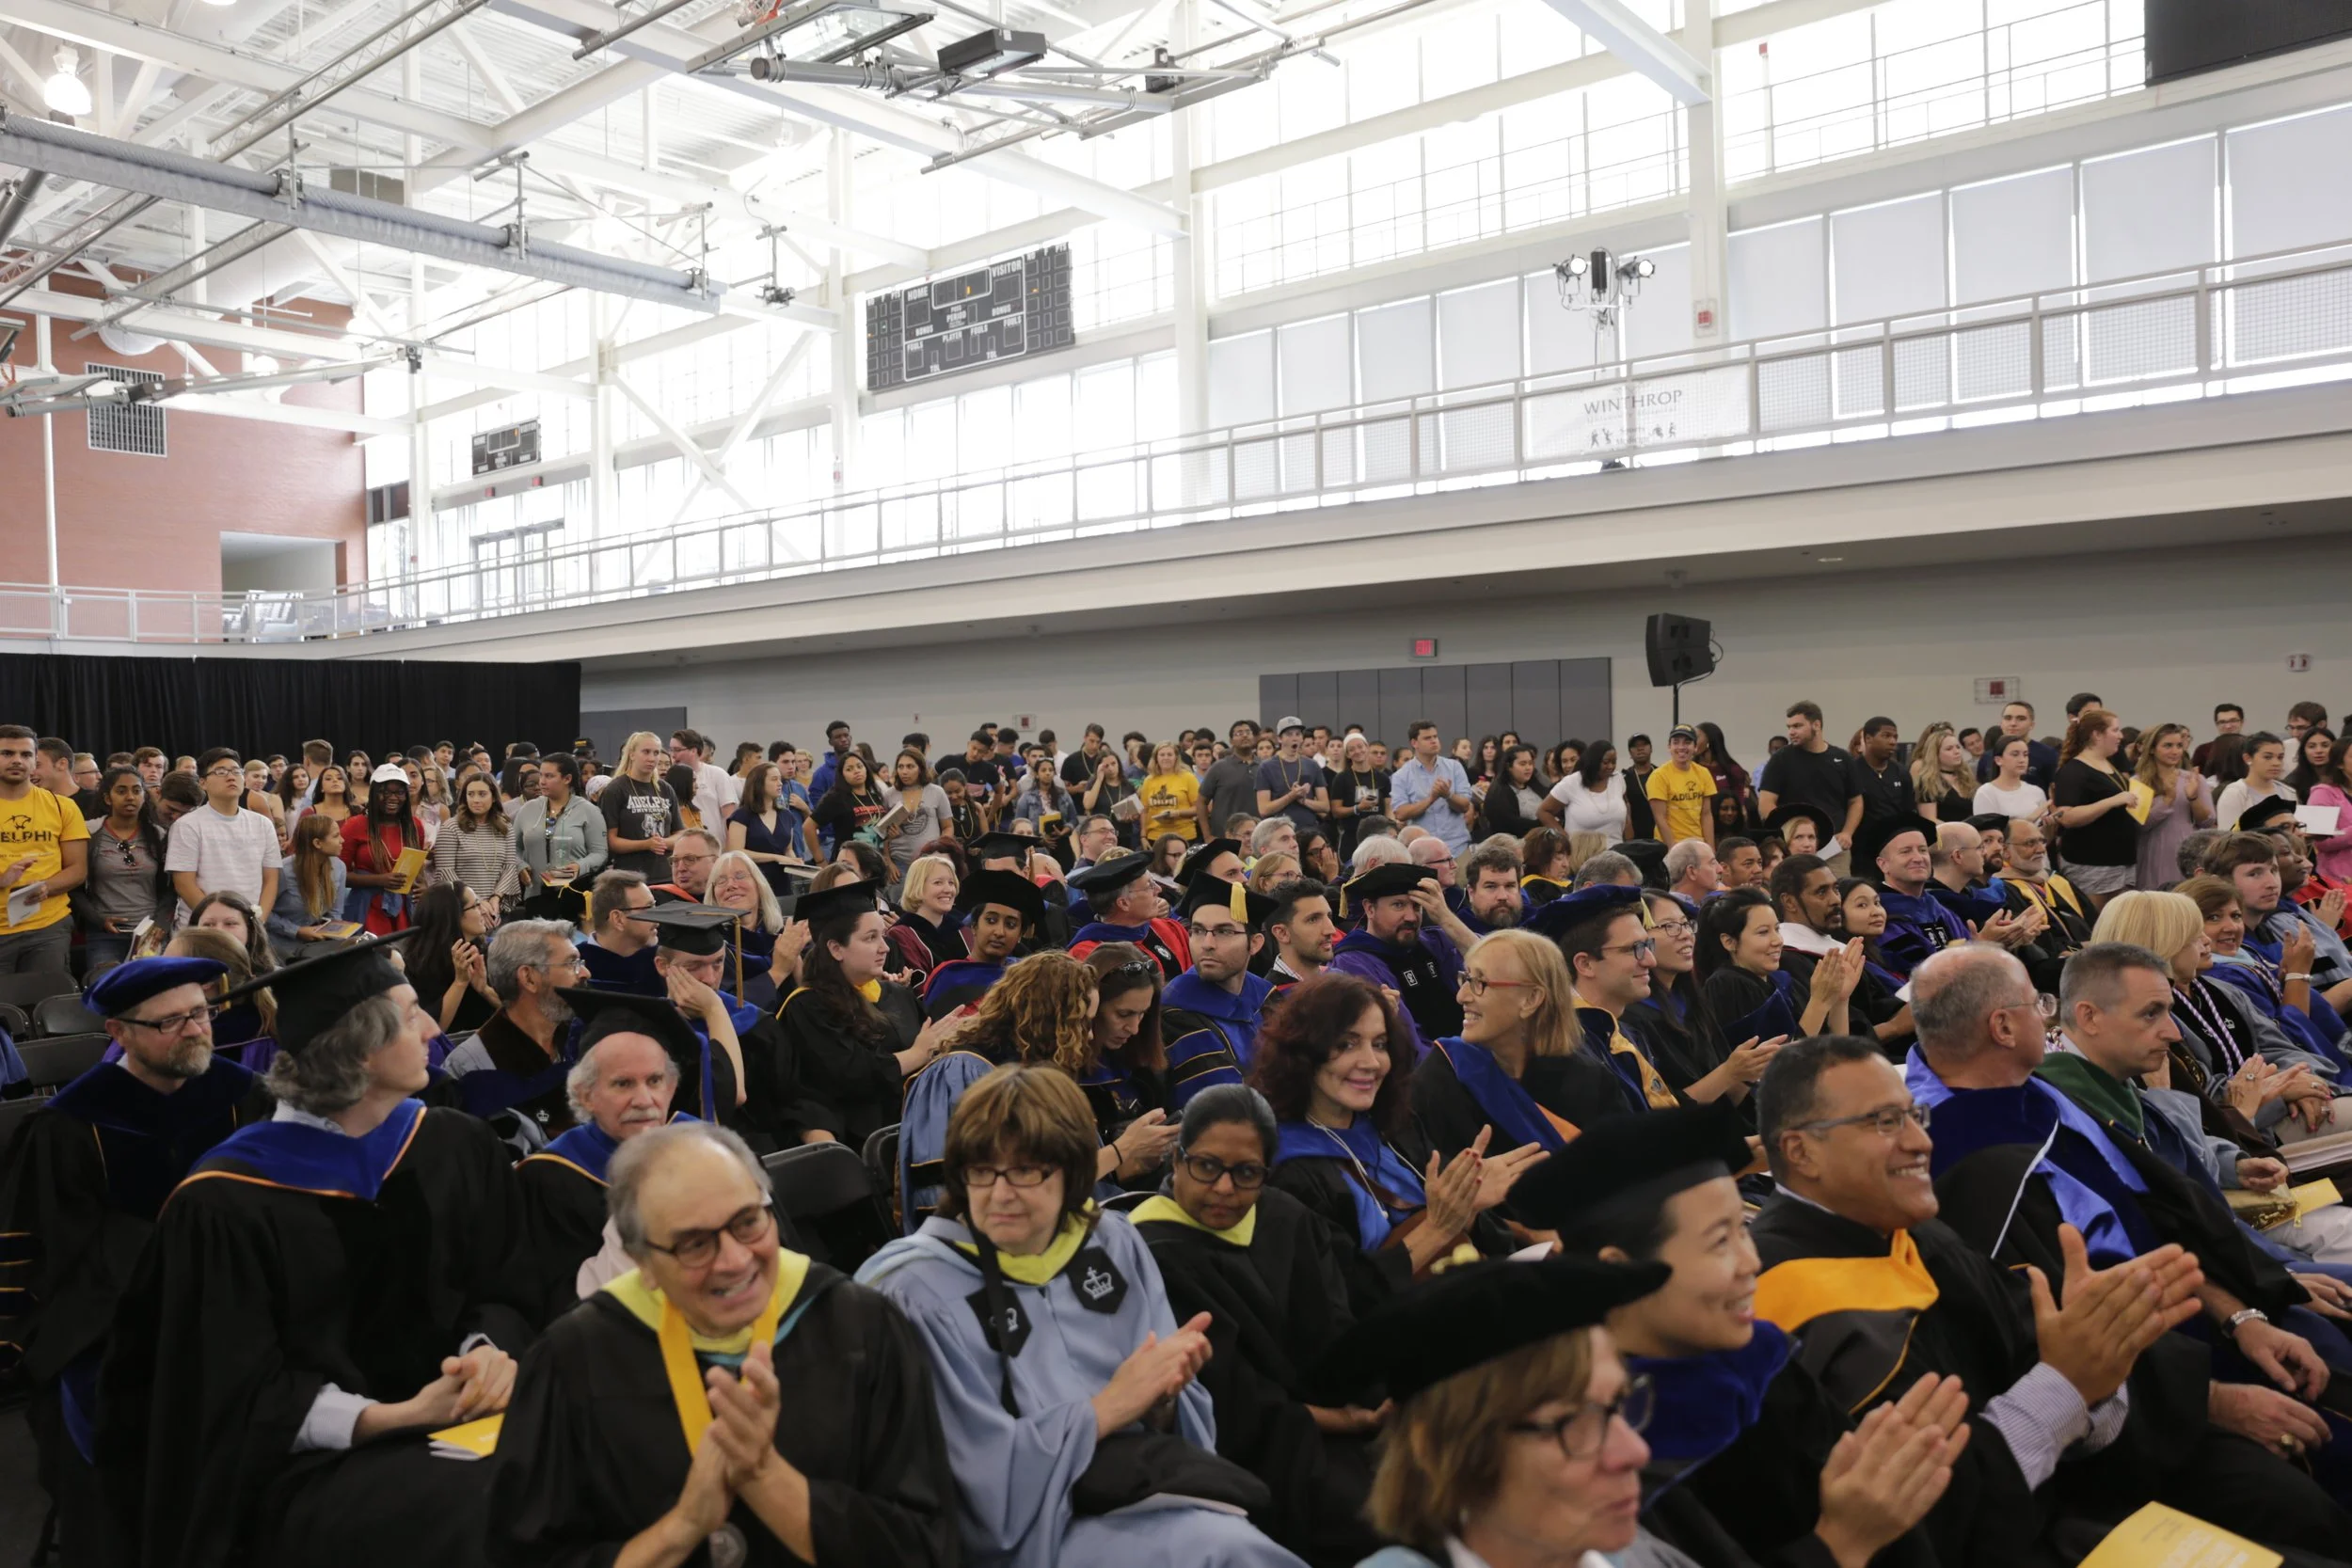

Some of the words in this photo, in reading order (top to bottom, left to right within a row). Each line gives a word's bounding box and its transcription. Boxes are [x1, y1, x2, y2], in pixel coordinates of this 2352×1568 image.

[992, 260, 1022, 277] VISITOR
[907, 286, 929, 301] HOME
[946, 310, 966, 323] PERIOD
[992, 304, 1011, 317] BONUS
[1003, 315, 1022, 327] FOULS
[915, 325, 933, 337] BONUS
[970, 325, 988, 336] FOULS
[942, 331, 962, 343] PLAYER
[907, 341, 923, 353] FOULS
